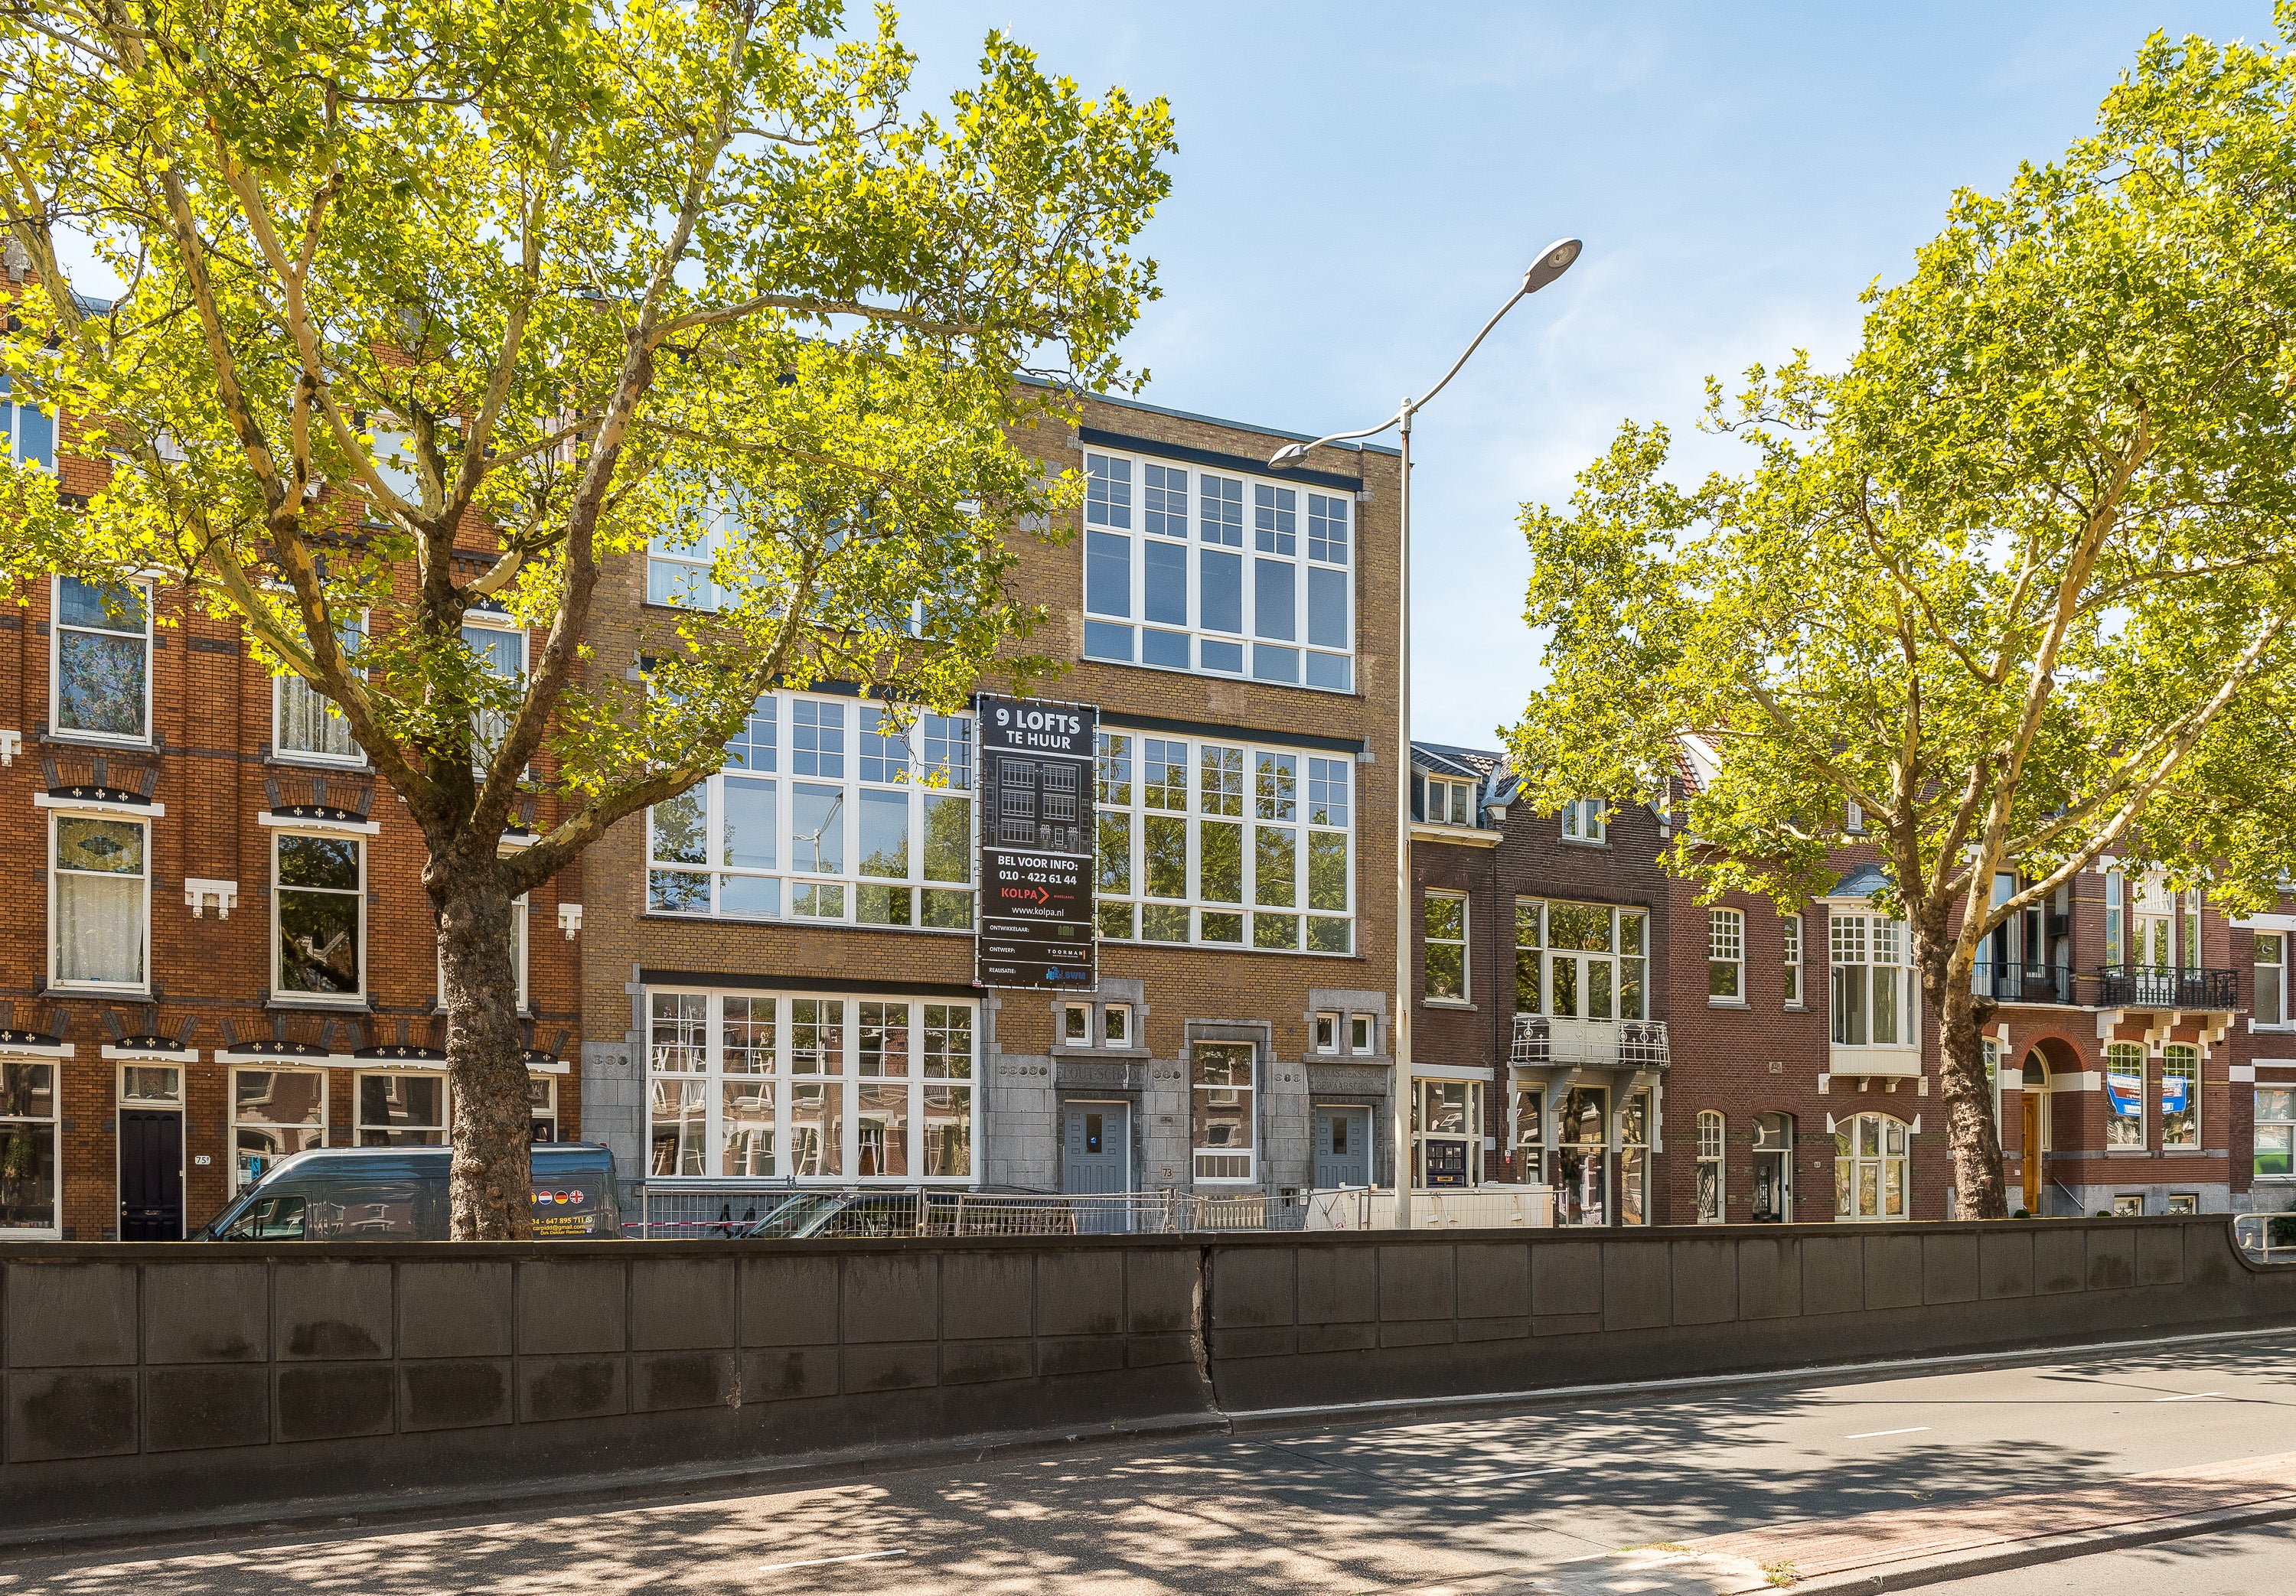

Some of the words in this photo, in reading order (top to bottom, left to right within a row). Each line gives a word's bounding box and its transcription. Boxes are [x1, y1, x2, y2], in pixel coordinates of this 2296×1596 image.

[996, 708, 1009, 726] 9
[1016, 710, 1081, 734] LOFTS
[1006, 731, 1023, 744] TE
[1027, 733, 1071, 750] HUUR
[998, 855, 1016, 866] BEL
[1017, 857, 1048, 868] VOOR
[1050, 859, 1078, 871] INFO:
[999, 871, 1019, 880] 010
[1027, 872, 1047, 883] 422
[1049, 874, 1062, 884] 61
[1064, 875, 1077, 885] 44
[1001, 888, 1038, 900] KOLPA
[1012, 907, 1065, 918] www.kolpa.nl
[990, 924, 1029, 933] ONTWIKKELAAR:
[1162, 1168, 1172, 1177] 73
